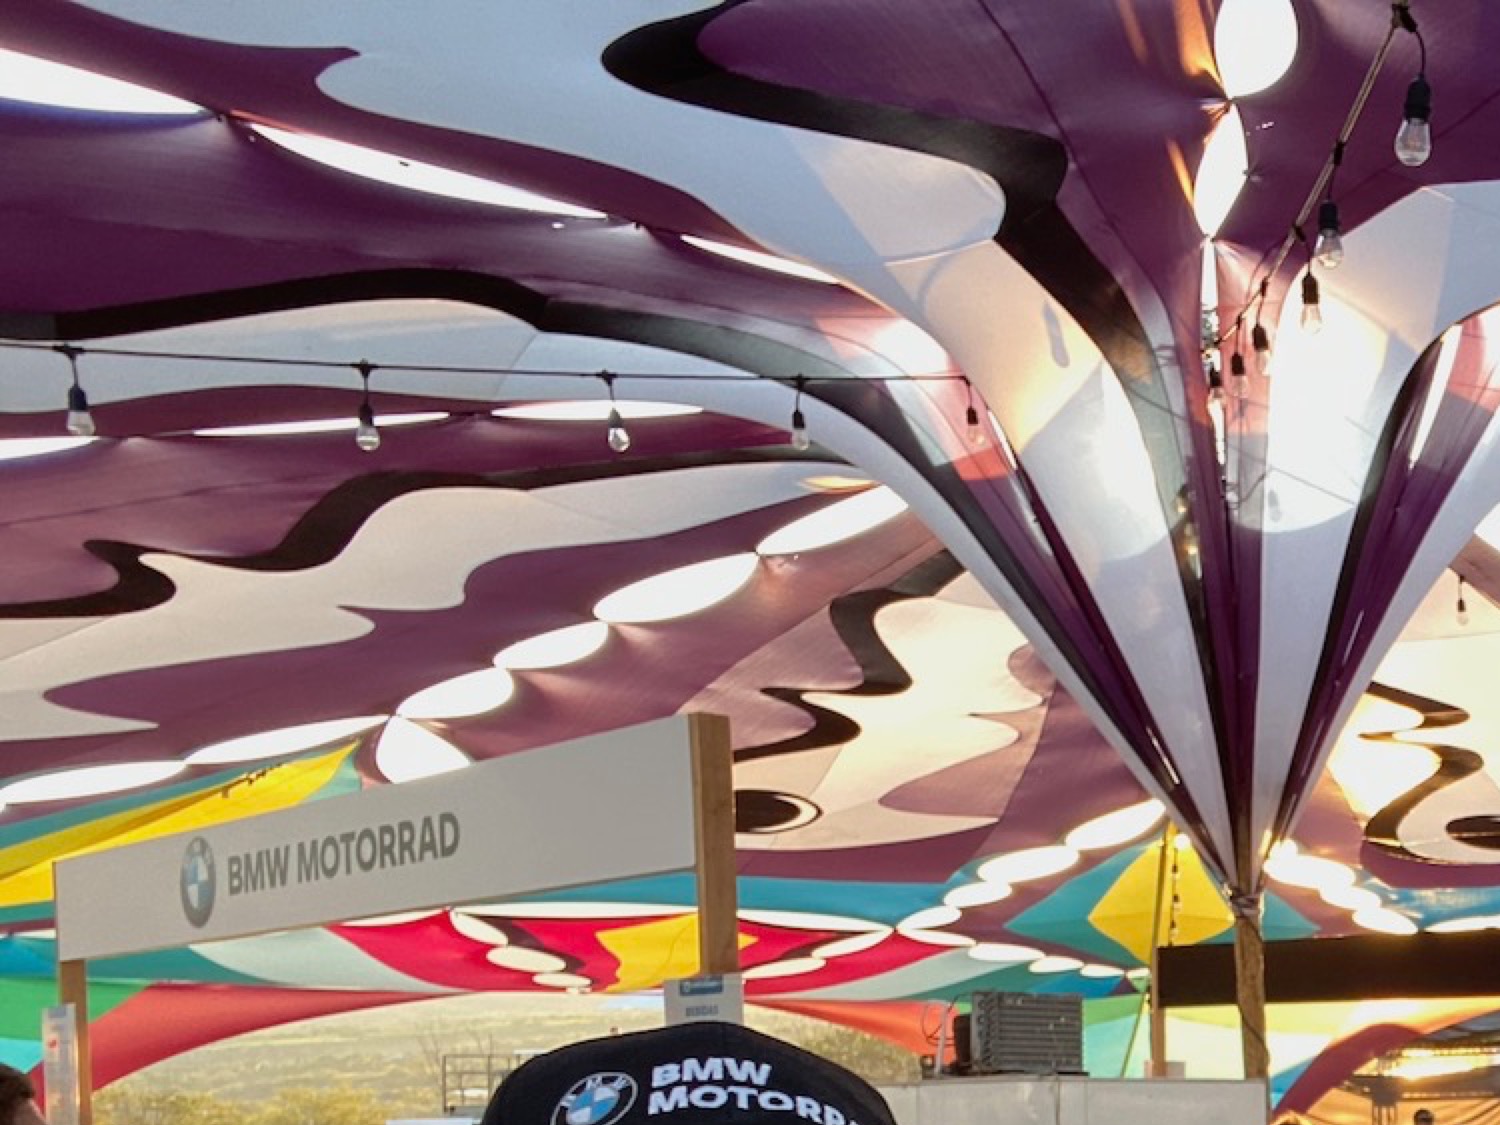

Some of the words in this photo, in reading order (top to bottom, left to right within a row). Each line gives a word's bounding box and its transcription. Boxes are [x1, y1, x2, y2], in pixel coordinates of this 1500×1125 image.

[227, 844, 291, 897] BMW
[296, 811, 461, 884] MOTORRAD
[651, 1057, 772, 1088] BMW
